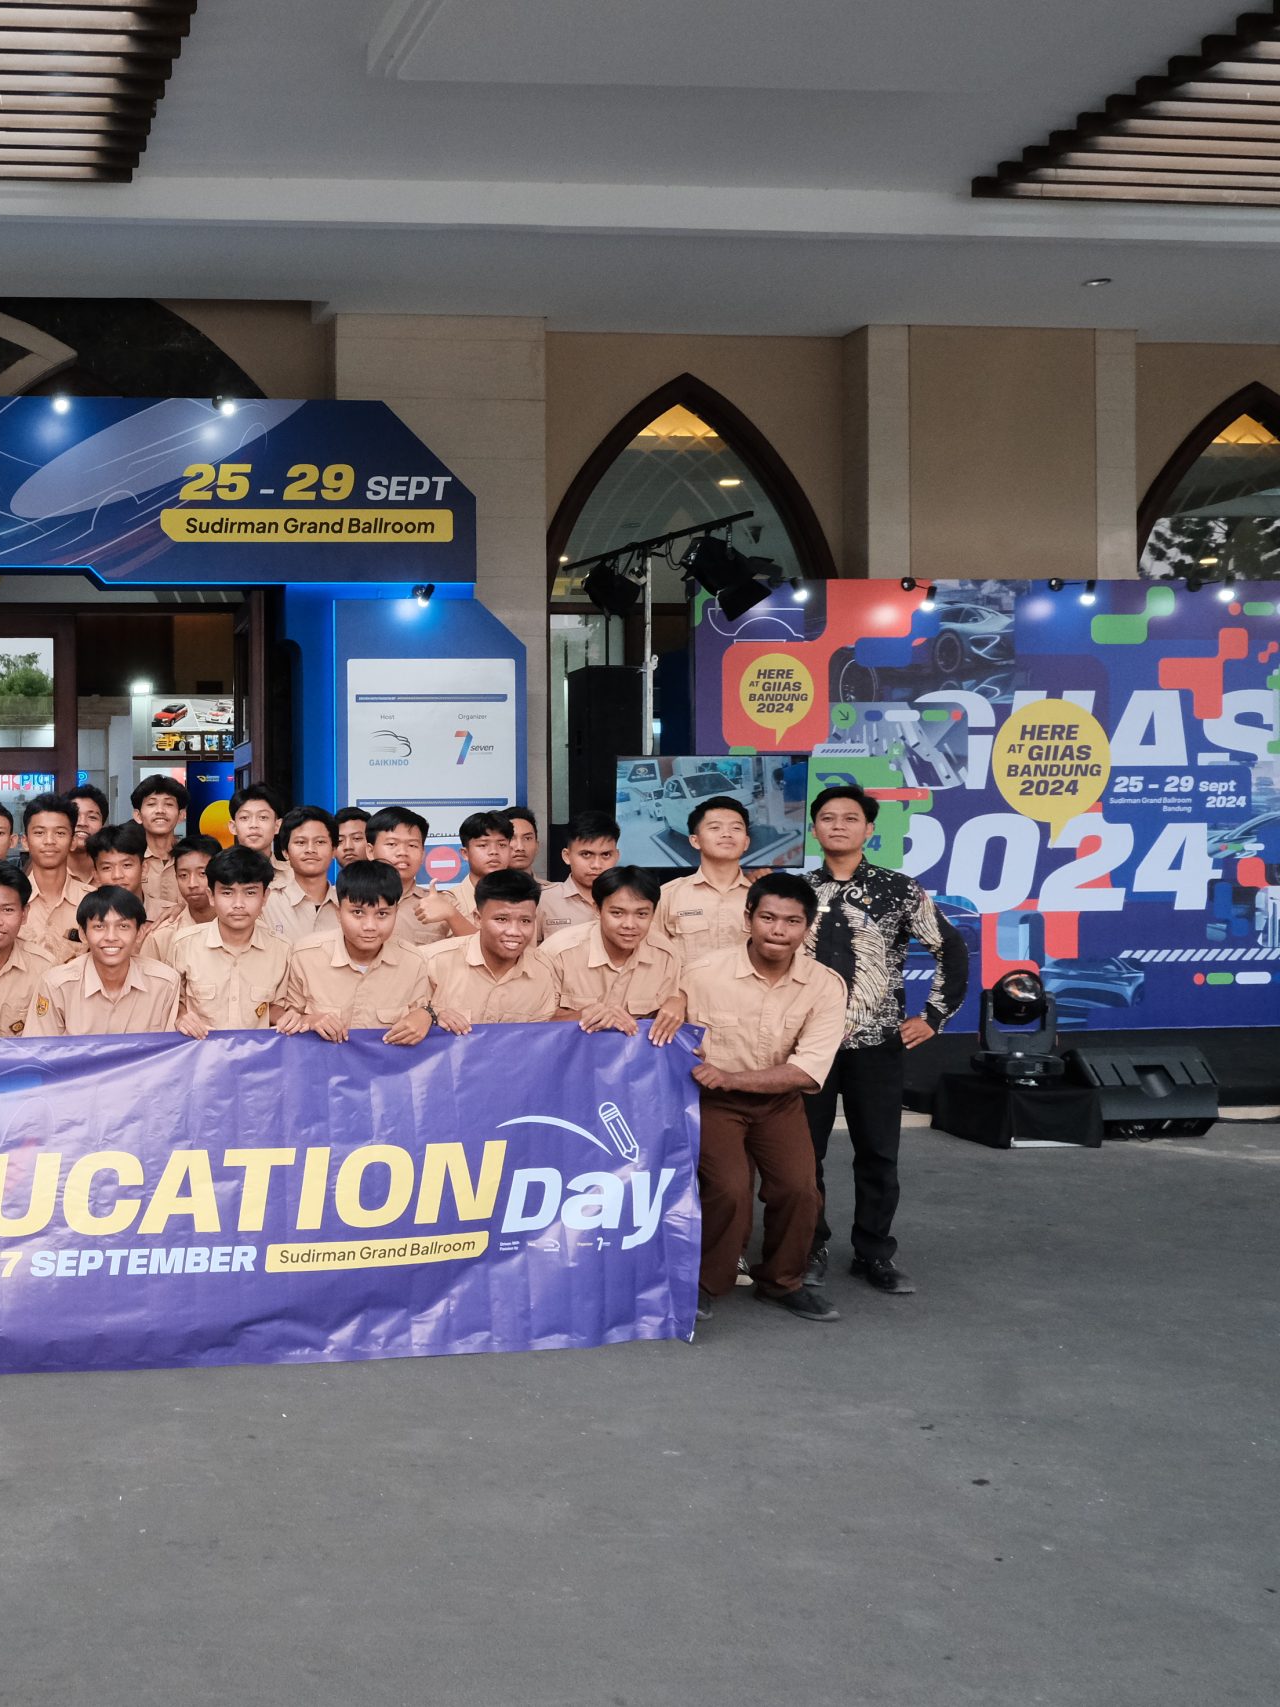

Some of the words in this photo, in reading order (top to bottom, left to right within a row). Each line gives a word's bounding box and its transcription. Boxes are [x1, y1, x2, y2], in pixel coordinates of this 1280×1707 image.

[179, 463, 252, 500] 25
[282, 463, 355, 500] 29
[366, 476, 452, 501] SEPT
[185, 517, 279, 534] Sudirman
[283, 517, 343, 534] Grand
[348, 517, 435, 534] Ballroom
[757, 669, 794, 679] HERE
[762, 682, 802, 692] GIIAS
[749, 693, 808, 701] BANDUNG
[756, 703, 794, 713] 2024
[904, 689, 1275, 790] GAS
[1020, 725, 1079, 740] HERE
[1007, 744, 1025, 754] AT
[1028, 745, 1092, 761] GIIAS
[1006, 763, 1102, 777] BANDUNG
[1019, 779, 1078, 796] 2024
[1113, 776, 1144, 792] 25
[1164, 776, 1194, 792] 29
[1199, 780, 1236, 795] sept
[1163, 796, 1192, 804] Ballroom
[1206, 795, 1246, 808] 2024
[1163, 805, 1192, 813] Bandung
[501, 1167, 675, 1250] Day
[280, 1249, 355, 1264] Sudirman
[359, 1244, 407, 1260] Grand
[410, 1240, 475, 1256] Ballroom
[30, 1246, 257, 1278] SEPTEMBER
